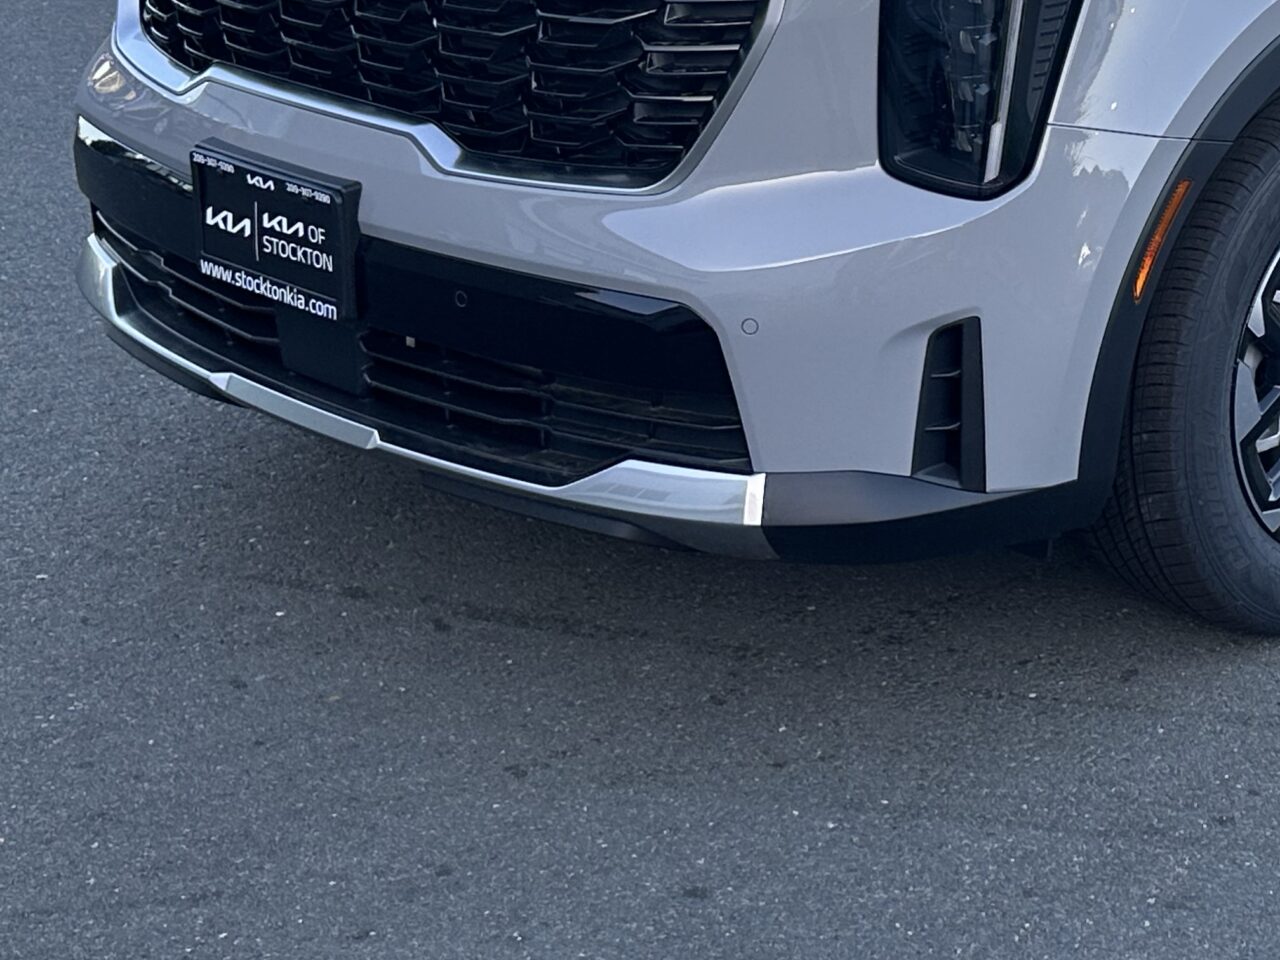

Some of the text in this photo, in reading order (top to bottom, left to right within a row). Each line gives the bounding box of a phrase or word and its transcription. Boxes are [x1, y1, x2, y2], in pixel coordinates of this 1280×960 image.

[246, 173, 275, 191] KIA
[206, 206, 251, 238] KIA
[262, 212, 326, 245] KIA OF
[263, 235, 333, 272] STOCKTON
[200, 258, 337, 320] www.stocktonkia.com
